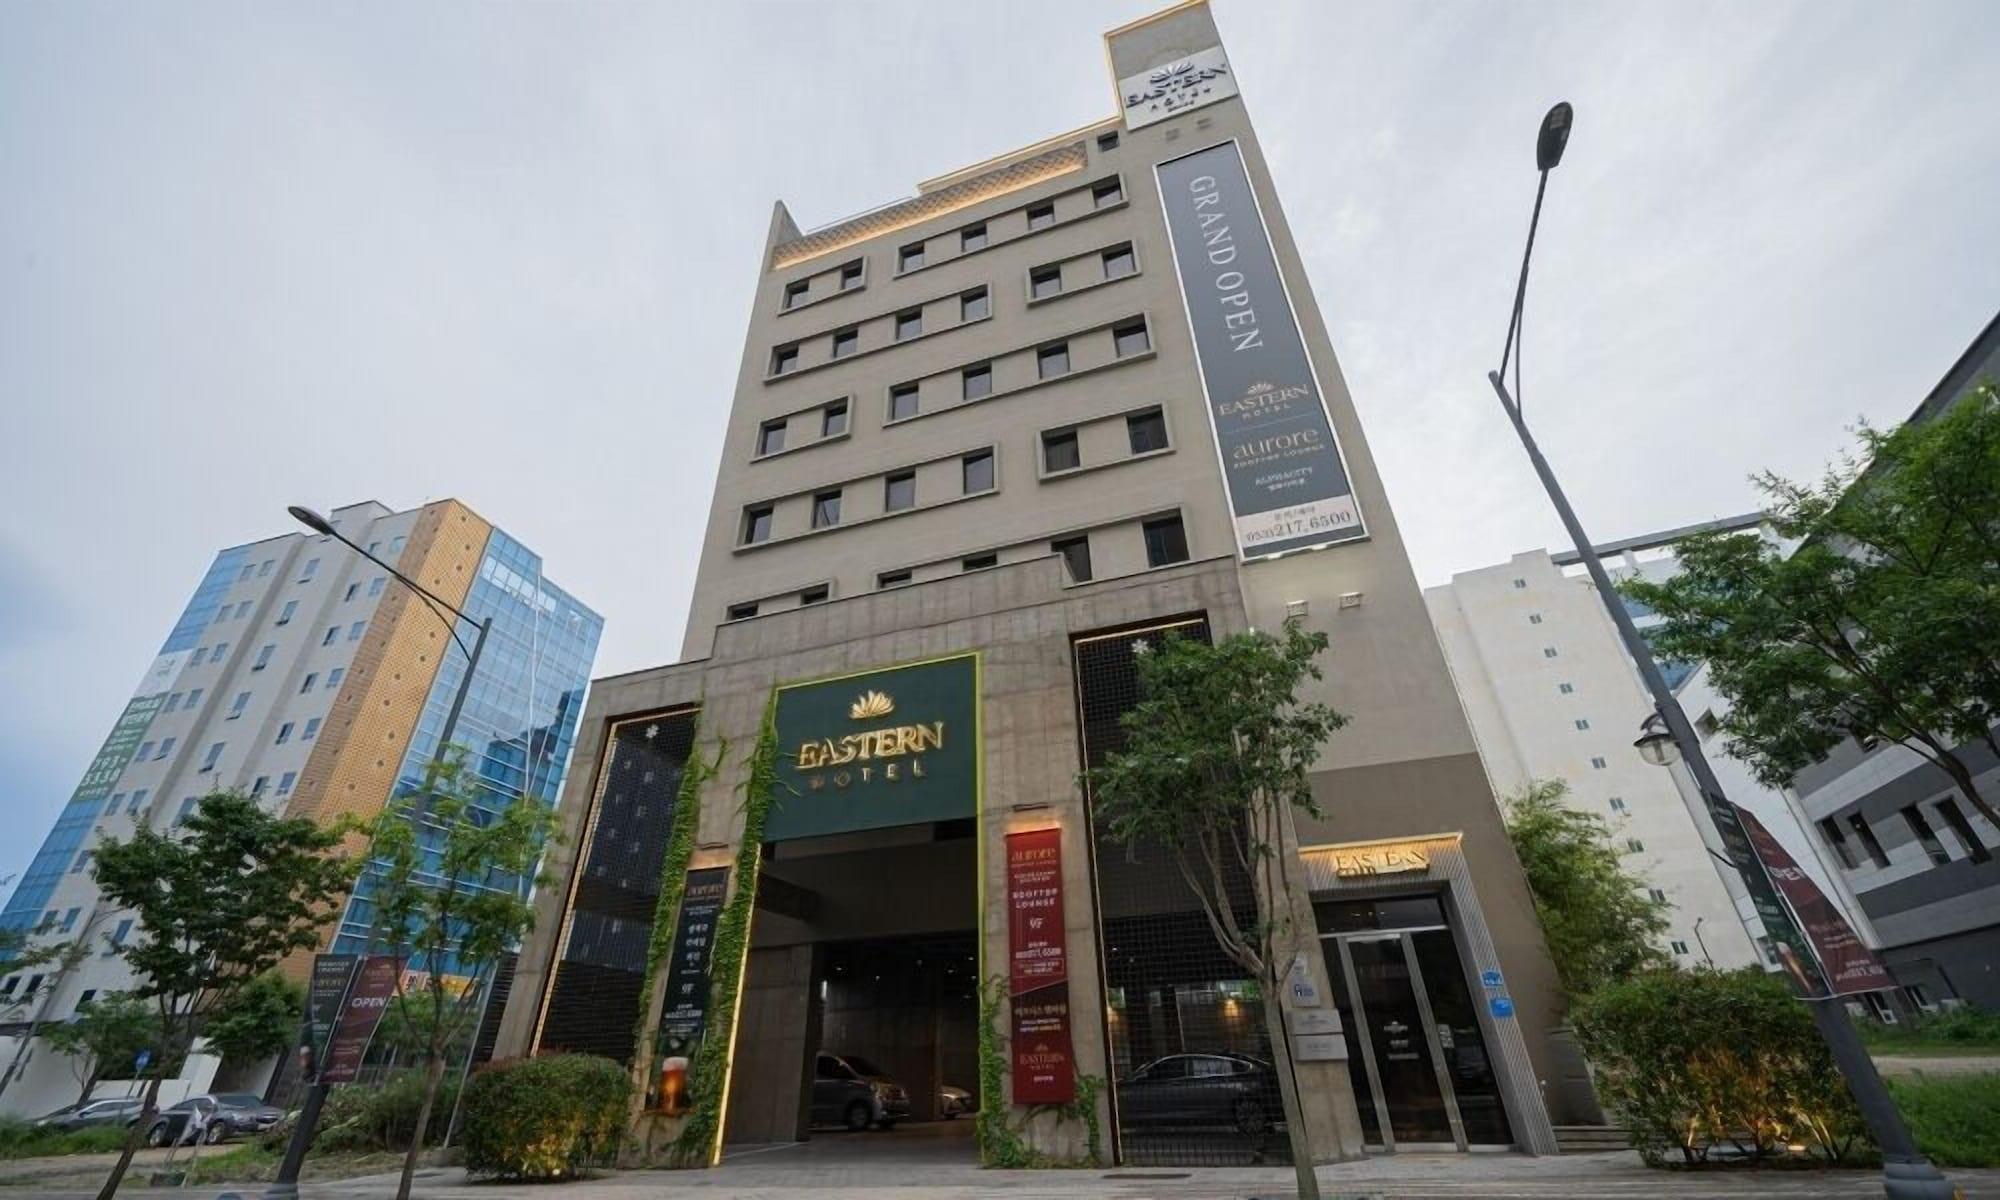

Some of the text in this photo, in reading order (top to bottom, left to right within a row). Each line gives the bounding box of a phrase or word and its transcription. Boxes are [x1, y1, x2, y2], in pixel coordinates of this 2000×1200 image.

[1189, 175, 1264, 352] GRAND OPEN
[1218, 384, 1309, 416] EASTERN
[1233, 428, 1320, 459] aurore
[794, 721, 944, 769] EASTERN
[351, 997, 387, 1009] OPEN
